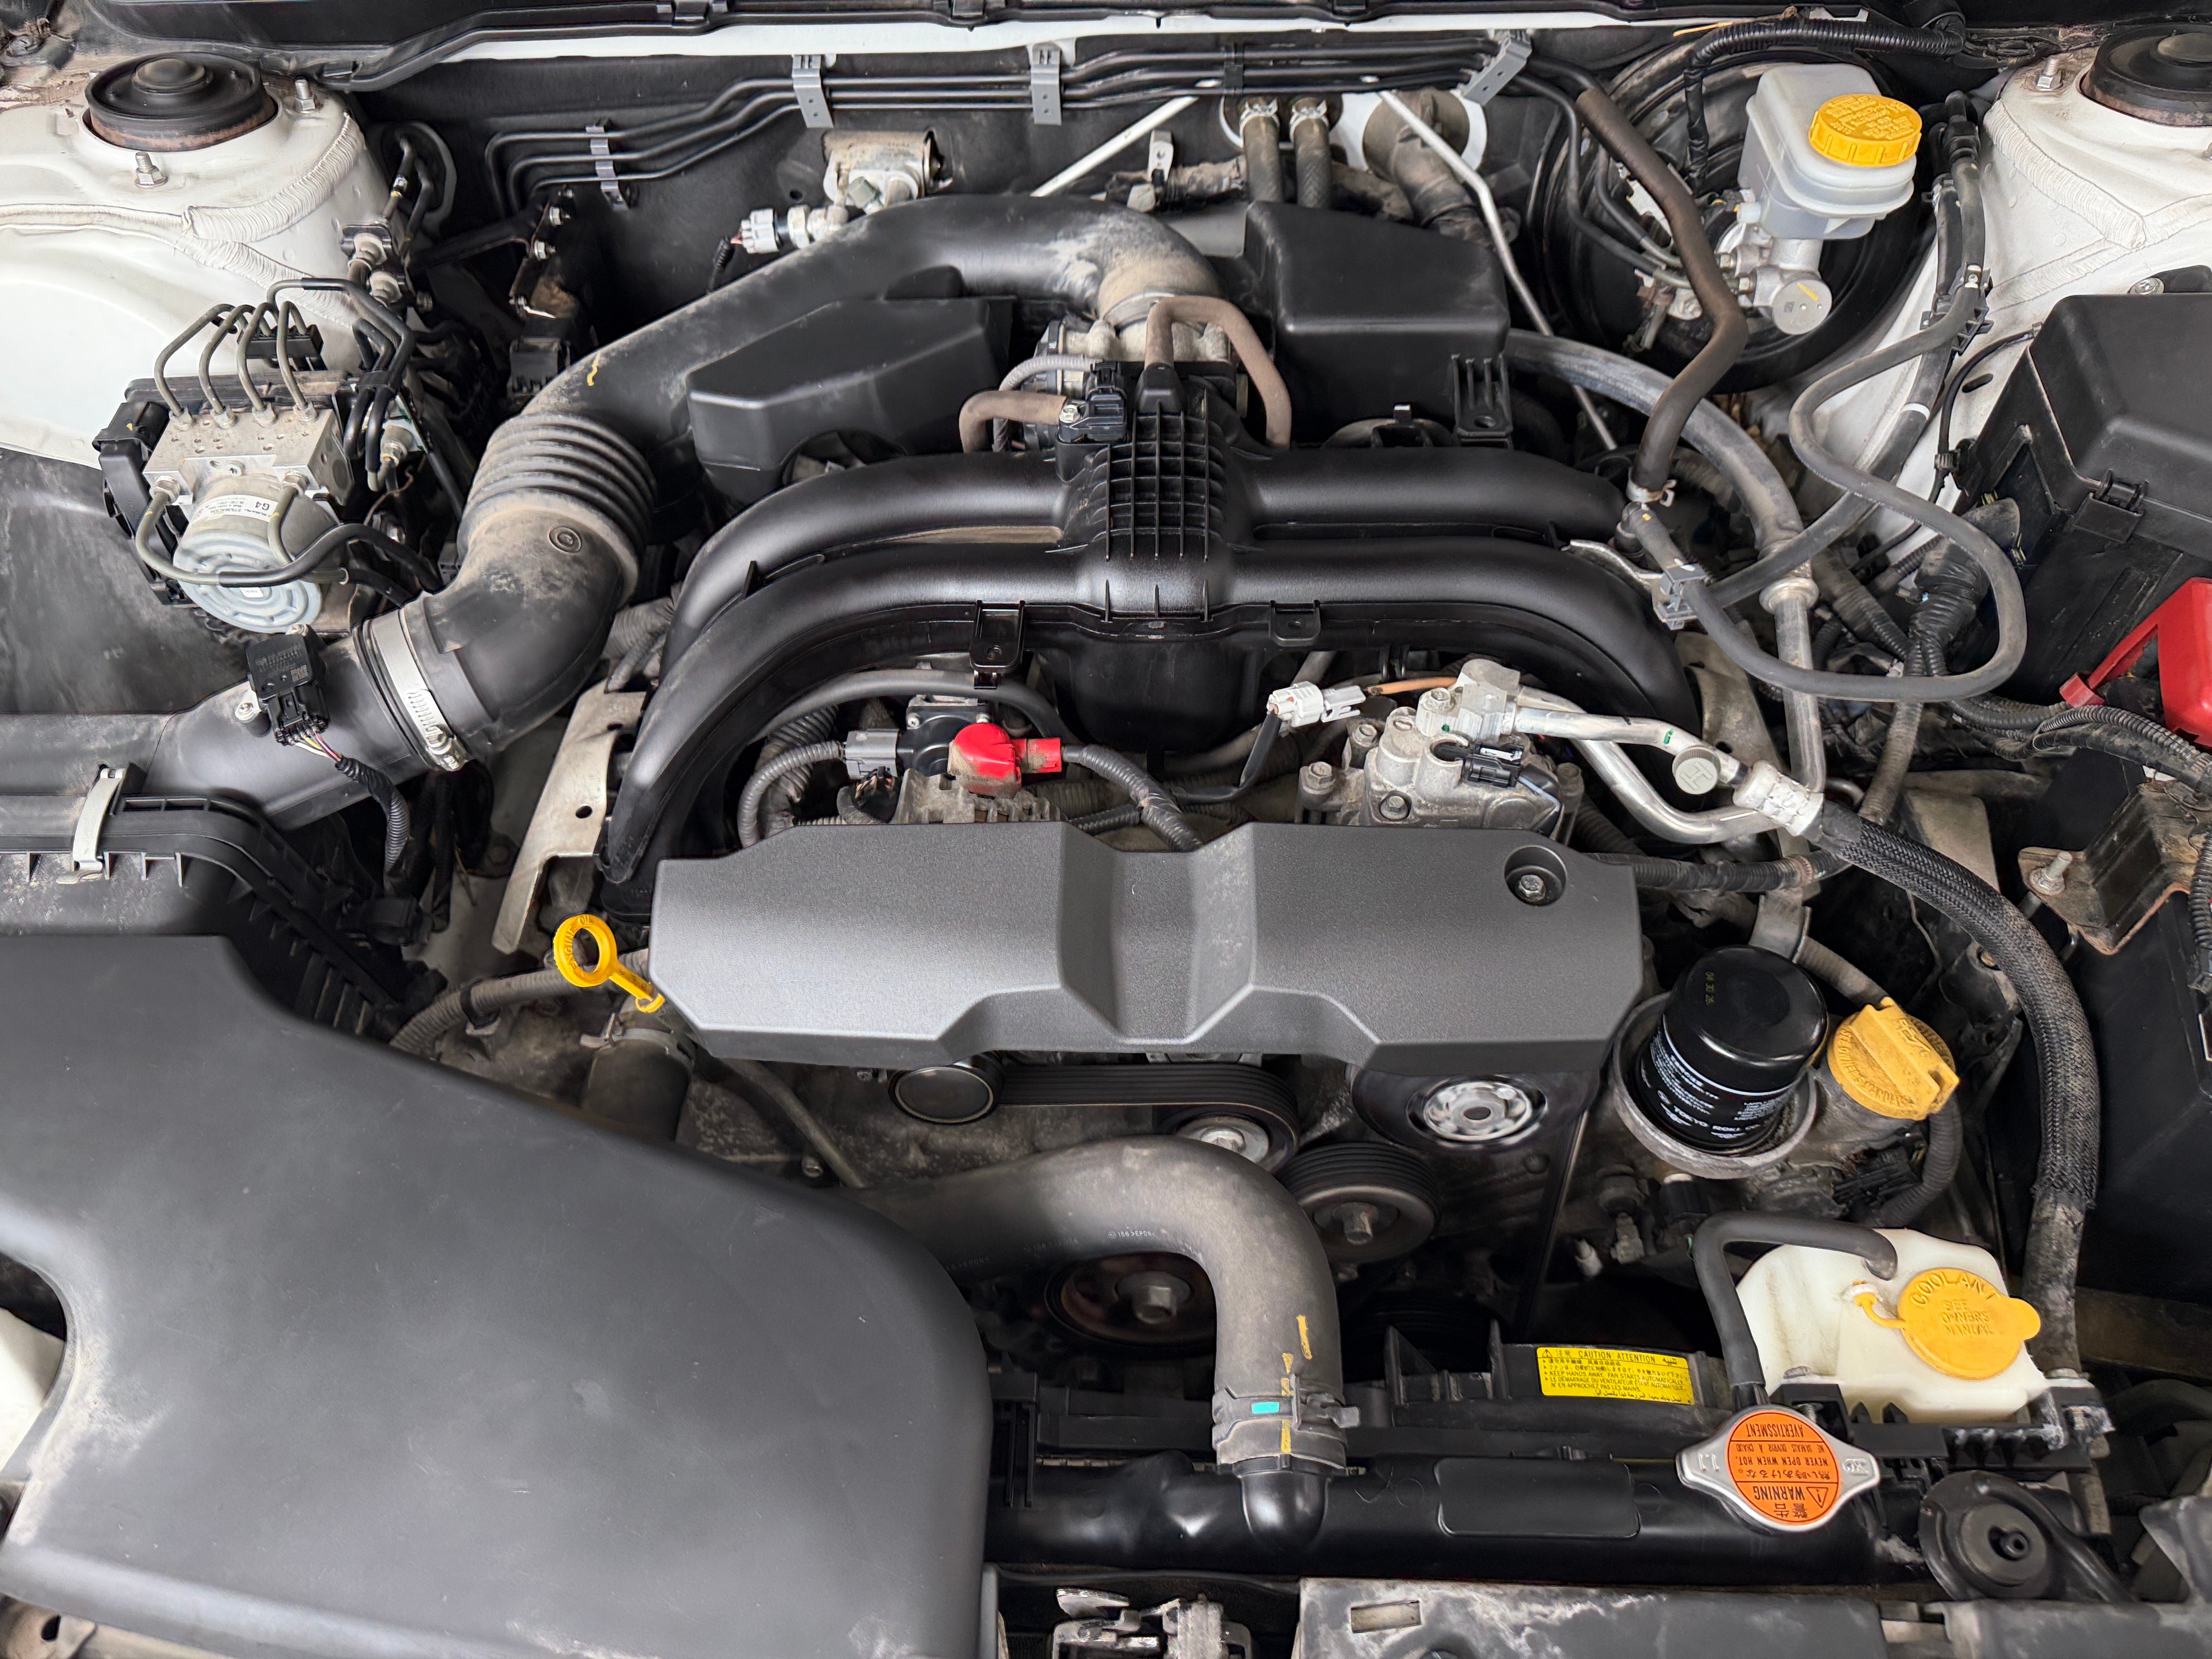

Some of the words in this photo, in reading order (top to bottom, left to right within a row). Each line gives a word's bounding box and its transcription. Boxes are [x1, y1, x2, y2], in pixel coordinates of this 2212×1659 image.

[255, 501, 270, 510] G4
[1680, 761, 1712, 790] H
[577, 915, 592, 926] OIL
[1909, 1271, 2002, 1306] COOLANT
[1943, 1299, 1969, 1312] SEE
[1945, 1323, 1994, 1336] MANUAL
[1578, 1350, 1611, 1359] CAUTION
[1617, 1352, 1655, 1363] ATTENTION
[1746, 1423, 1804, 1437] AVERTISSMENT
[1736, 1443, 1754, 1452] CHAUD
[1791, 1443, 1812, 1453] JAMAIS
[1735, 1456, 1753, 1465] HOT.
[1757, 1456, 1778, 1465] WHEN
[1781, 1456, 1801, 1466] OPEN
[1804, 1457, 1828, 1466] NEVER
[1753, 1485, 1806, 1501] WARNING
[1774, 1503, 1809, 1519] 警告
